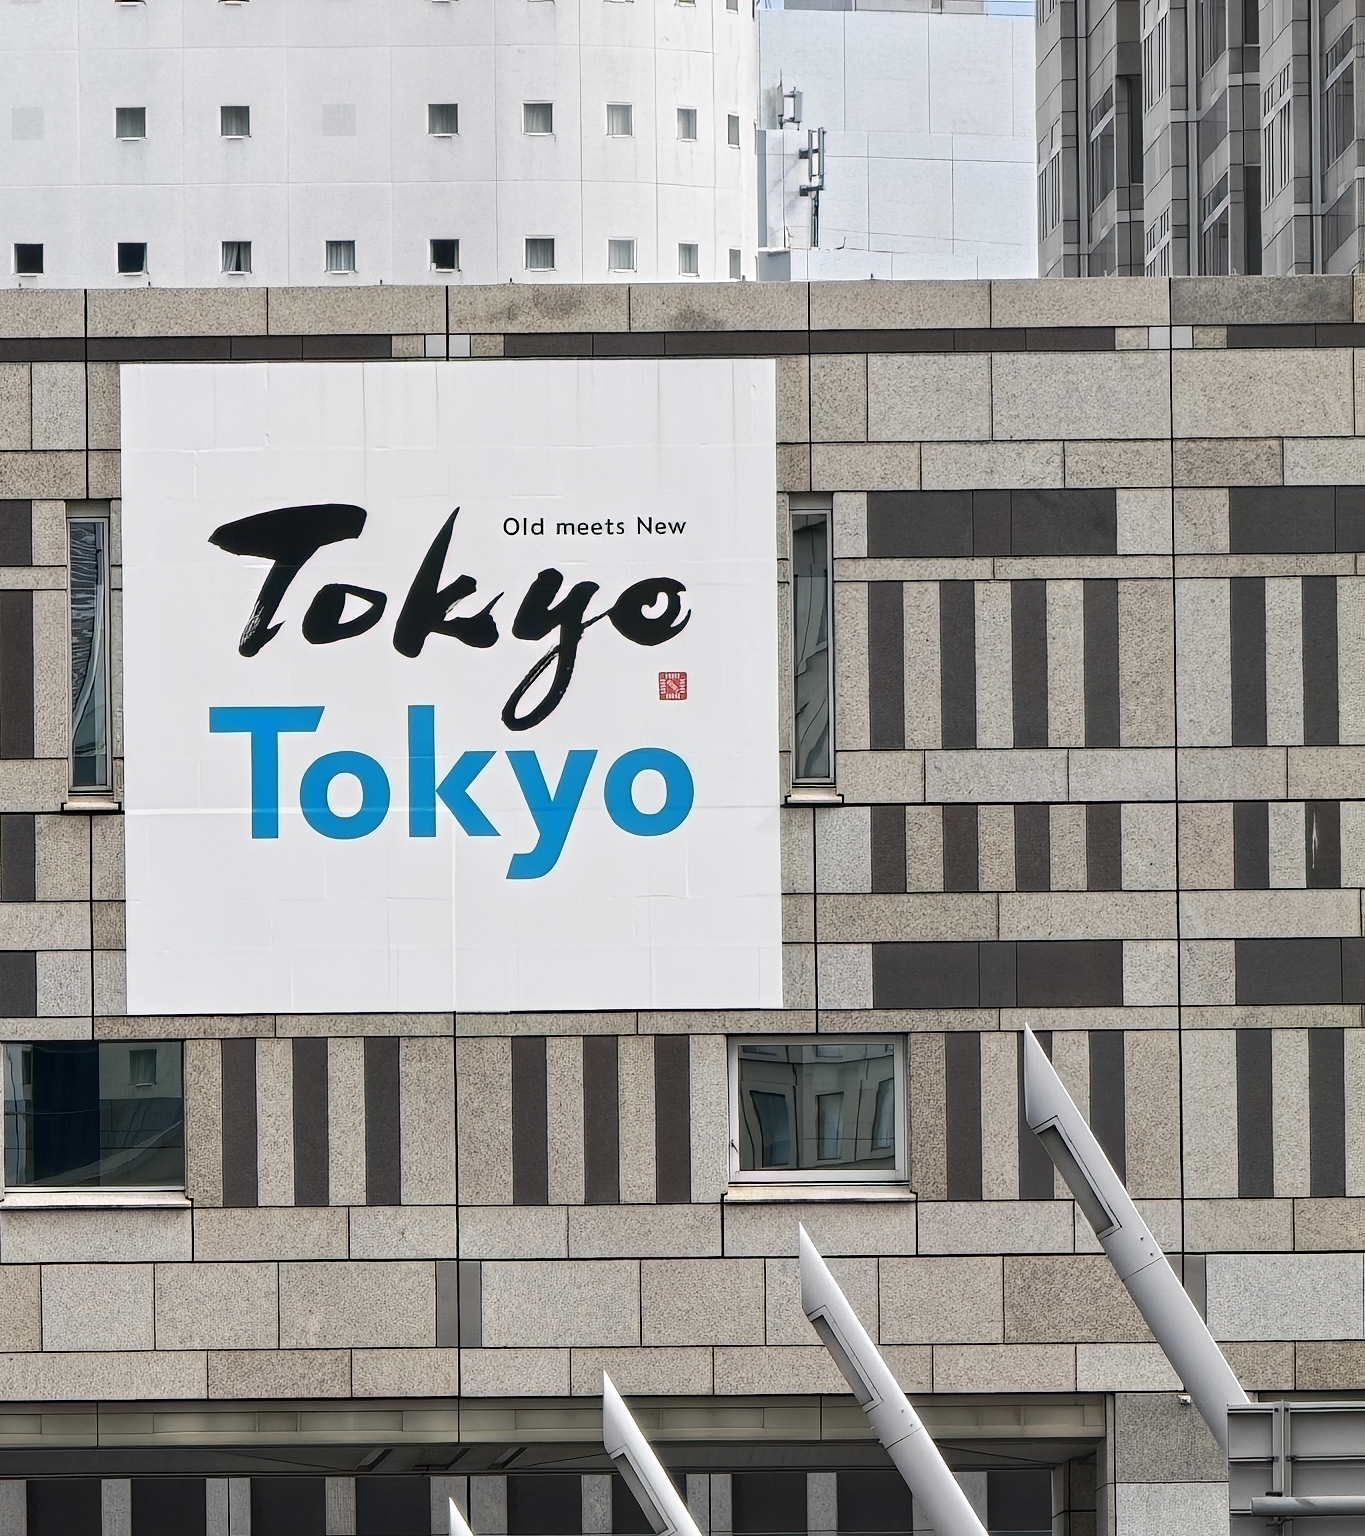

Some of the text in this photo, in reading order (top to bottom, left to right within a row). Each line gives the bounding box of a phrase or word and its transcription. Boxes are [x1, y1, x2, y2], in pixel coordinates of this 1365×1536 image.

[503, 516, 687, 536] Old meets New
[208, 503, 691, 731] Tokyo
[209, 705, 694, 880] Tokyo
